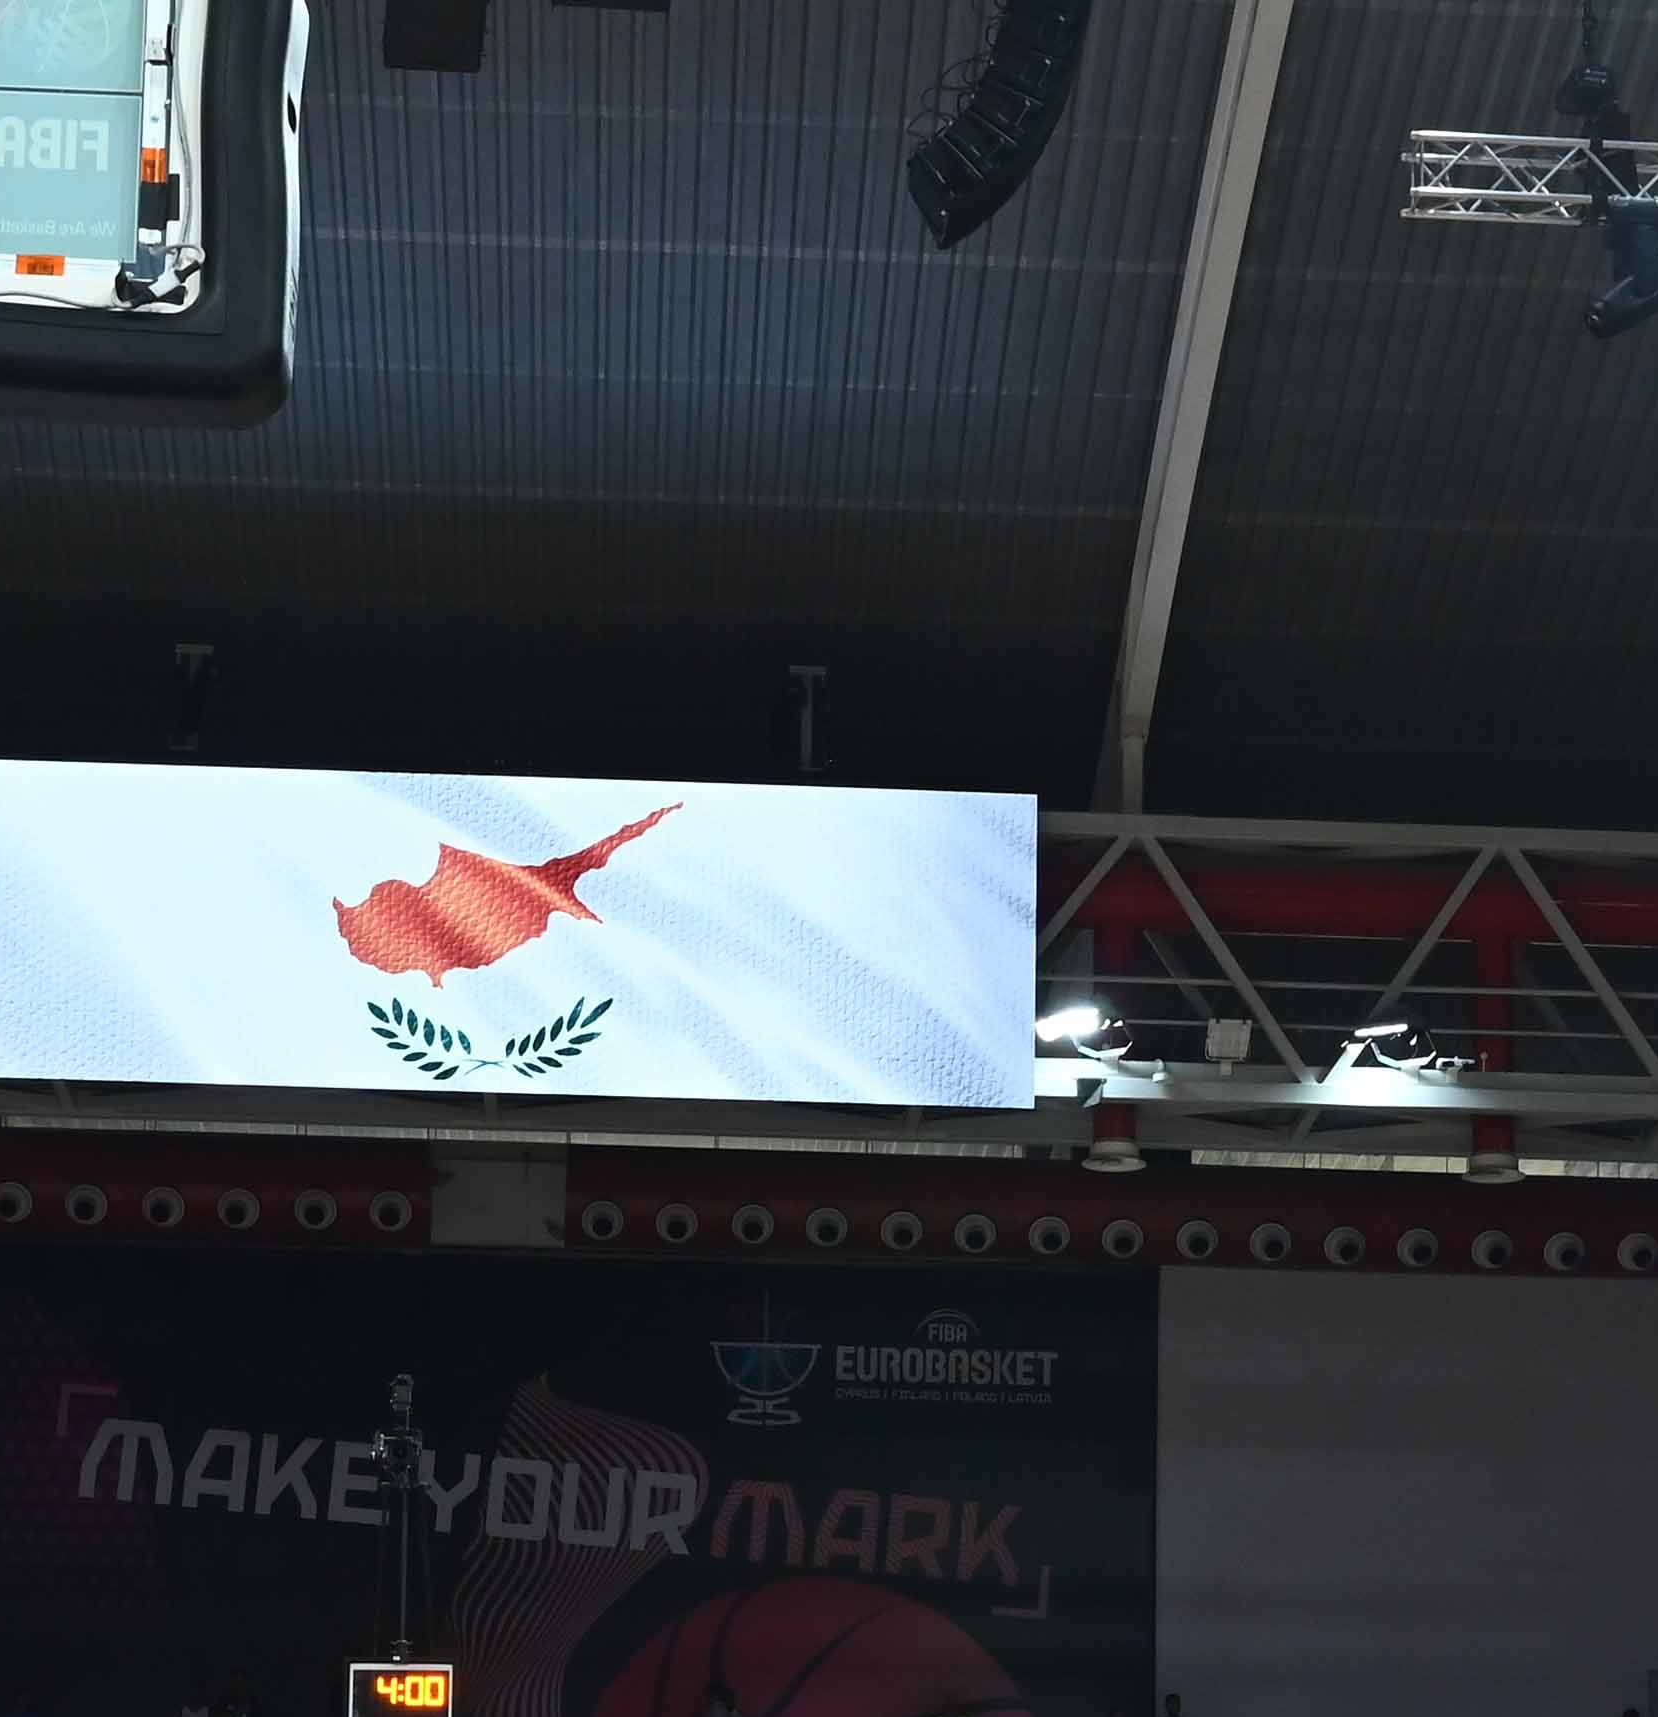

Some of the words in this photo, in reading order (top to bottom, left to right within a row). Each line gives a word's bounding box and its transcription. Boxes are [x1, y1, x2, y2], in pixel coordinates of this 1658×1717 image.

[928, 1323, 968, 1343] FIBA
[835, 1345, 1059, 1388] EUROBASKET
[78, 1418, 390, 1527] MAKE
[420, 1449, 697, 1556] YOUR
[711, 1479, 1023, 1586] MARK
[376, 1675, 446, 1708] 4:00
